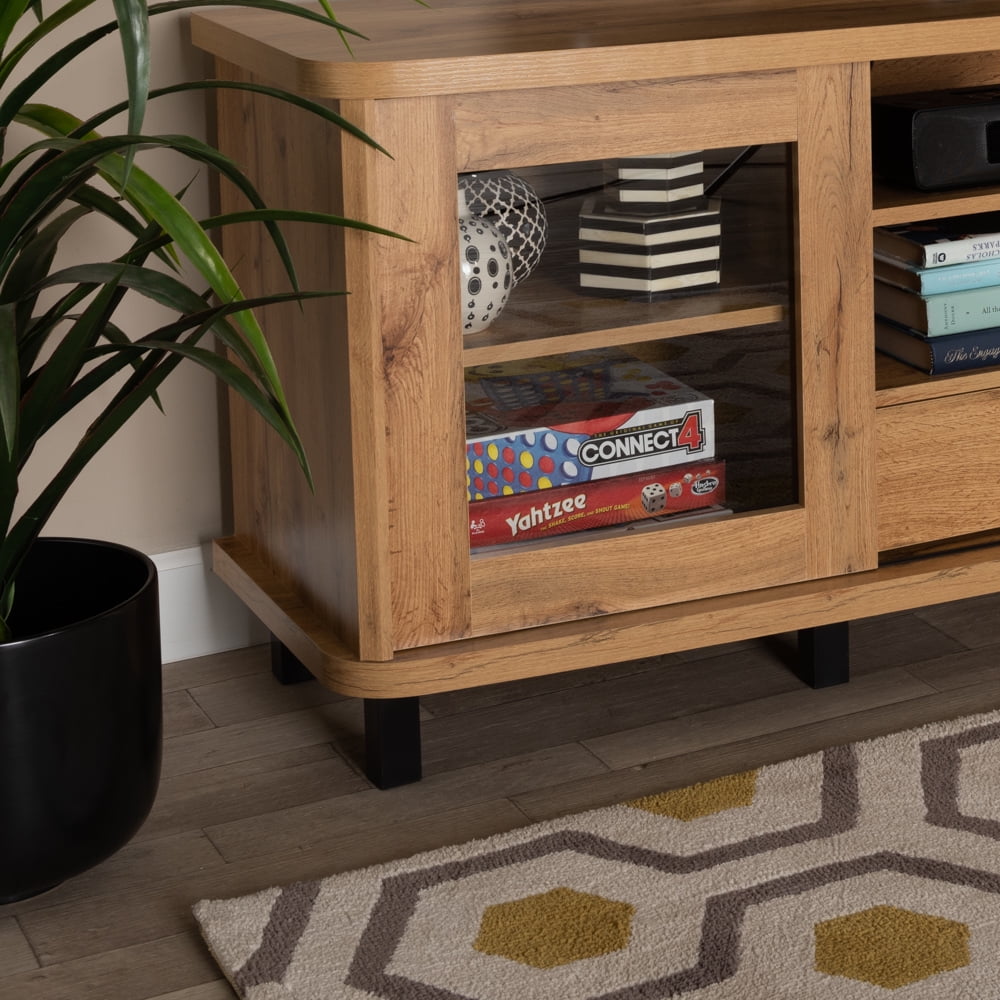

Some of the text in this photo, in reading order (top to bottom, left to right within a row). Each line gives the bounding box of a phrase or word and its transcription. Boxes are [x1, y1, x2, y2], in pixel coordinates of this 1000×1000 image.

[981, 306, 992, 314] All
[944, 346, 968, 363] The
[581, 414, 702, 463] CONNECT 4
[506, 493, 587, 536] Yahtzee
[548, 518, 567, 528] SHAKE,
[567, 511, 586, 522] SCORE,
[595, 504, 613, 514] SHOUT
